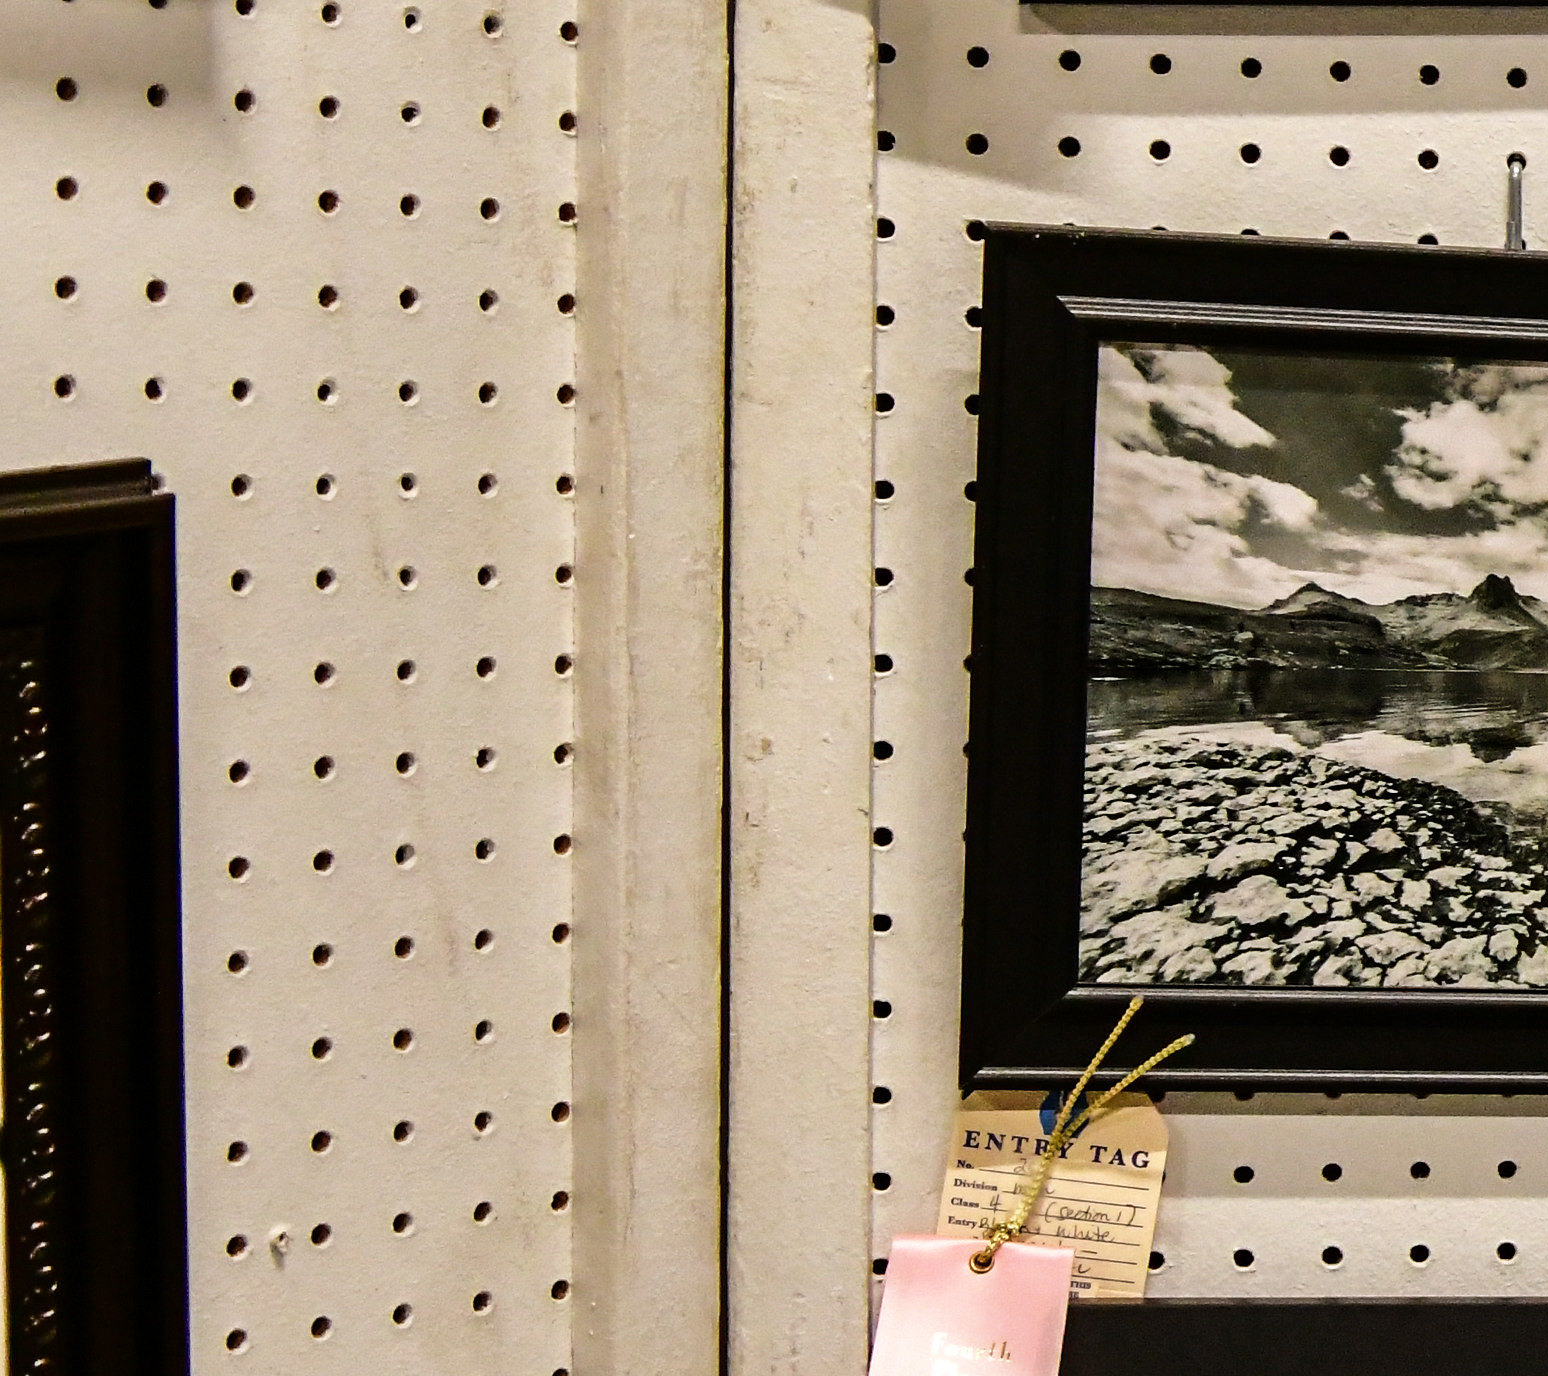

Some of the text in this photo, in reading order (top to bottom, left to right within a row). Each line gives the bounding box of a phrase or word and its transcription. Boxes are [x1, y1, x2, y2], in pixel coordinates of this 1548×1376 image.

[1090, 1145, 1150, 1169] TAG
[957, 1160, 975, 1170] No.
[953, 1178, 998, 1192] Division
[950, 1197, 980, 1209] Class
[948, 1216, 977, 1229] Entry
